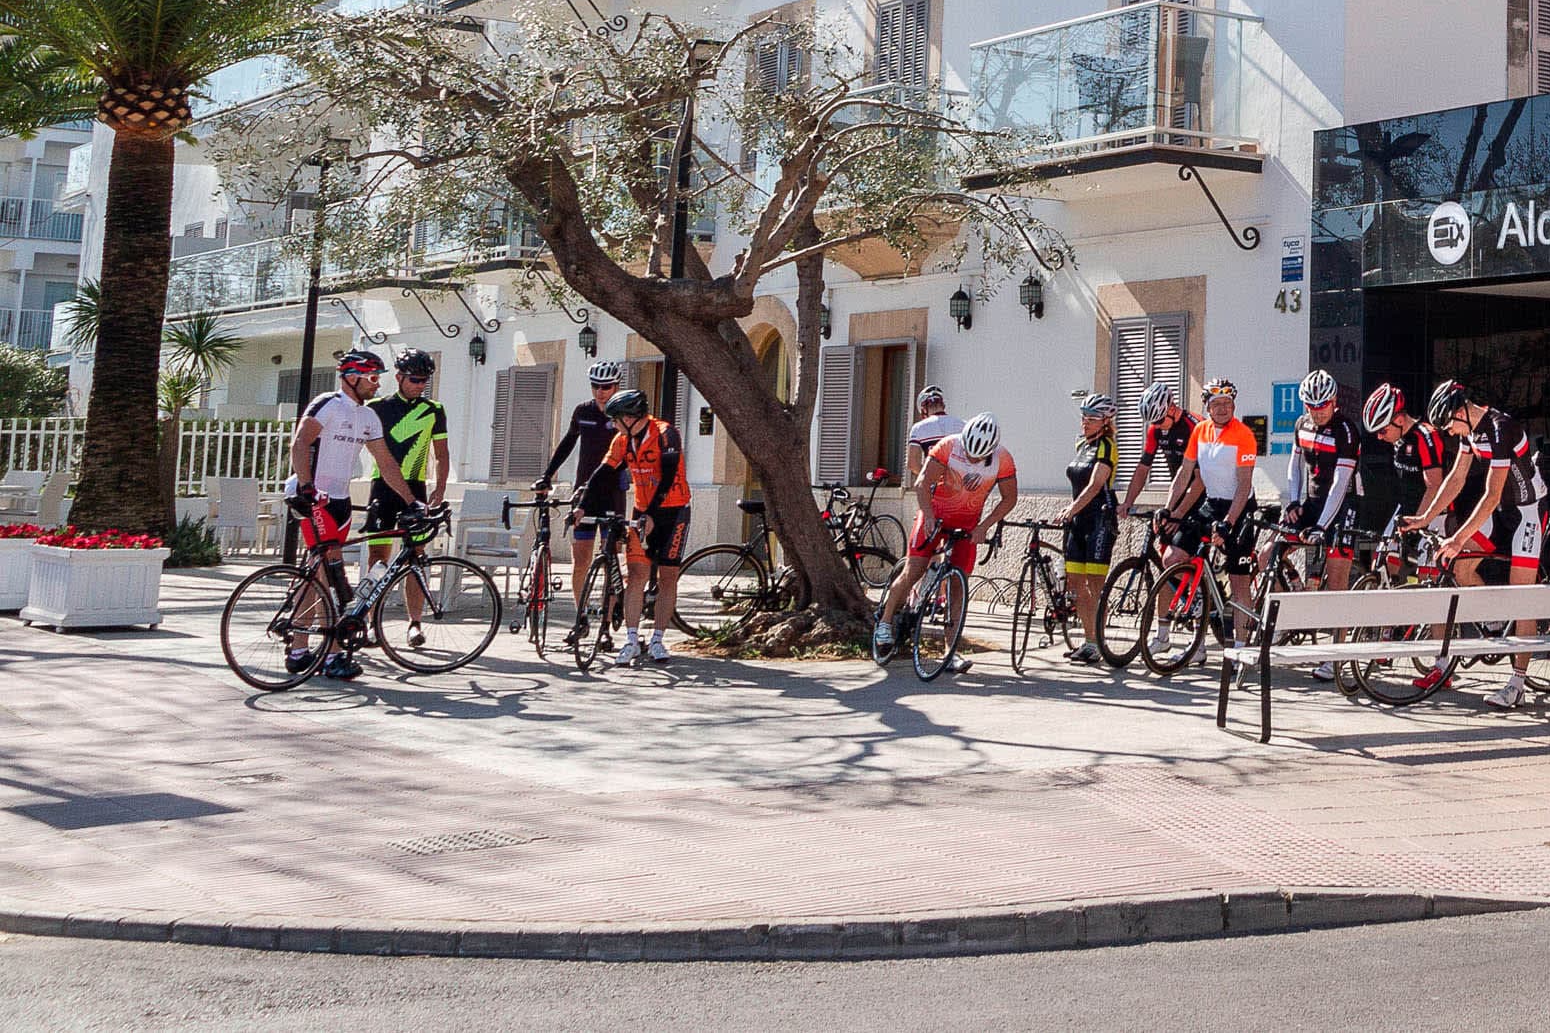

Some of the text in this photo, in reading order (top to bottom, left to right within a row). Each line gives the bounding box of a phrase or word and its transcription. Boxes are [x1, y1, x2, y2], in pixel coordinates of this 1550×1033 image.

[1274, 288, 1302, 313] 43
[1280, 387, 1296, 413] H
[1239, 556, 1252, 565] po
